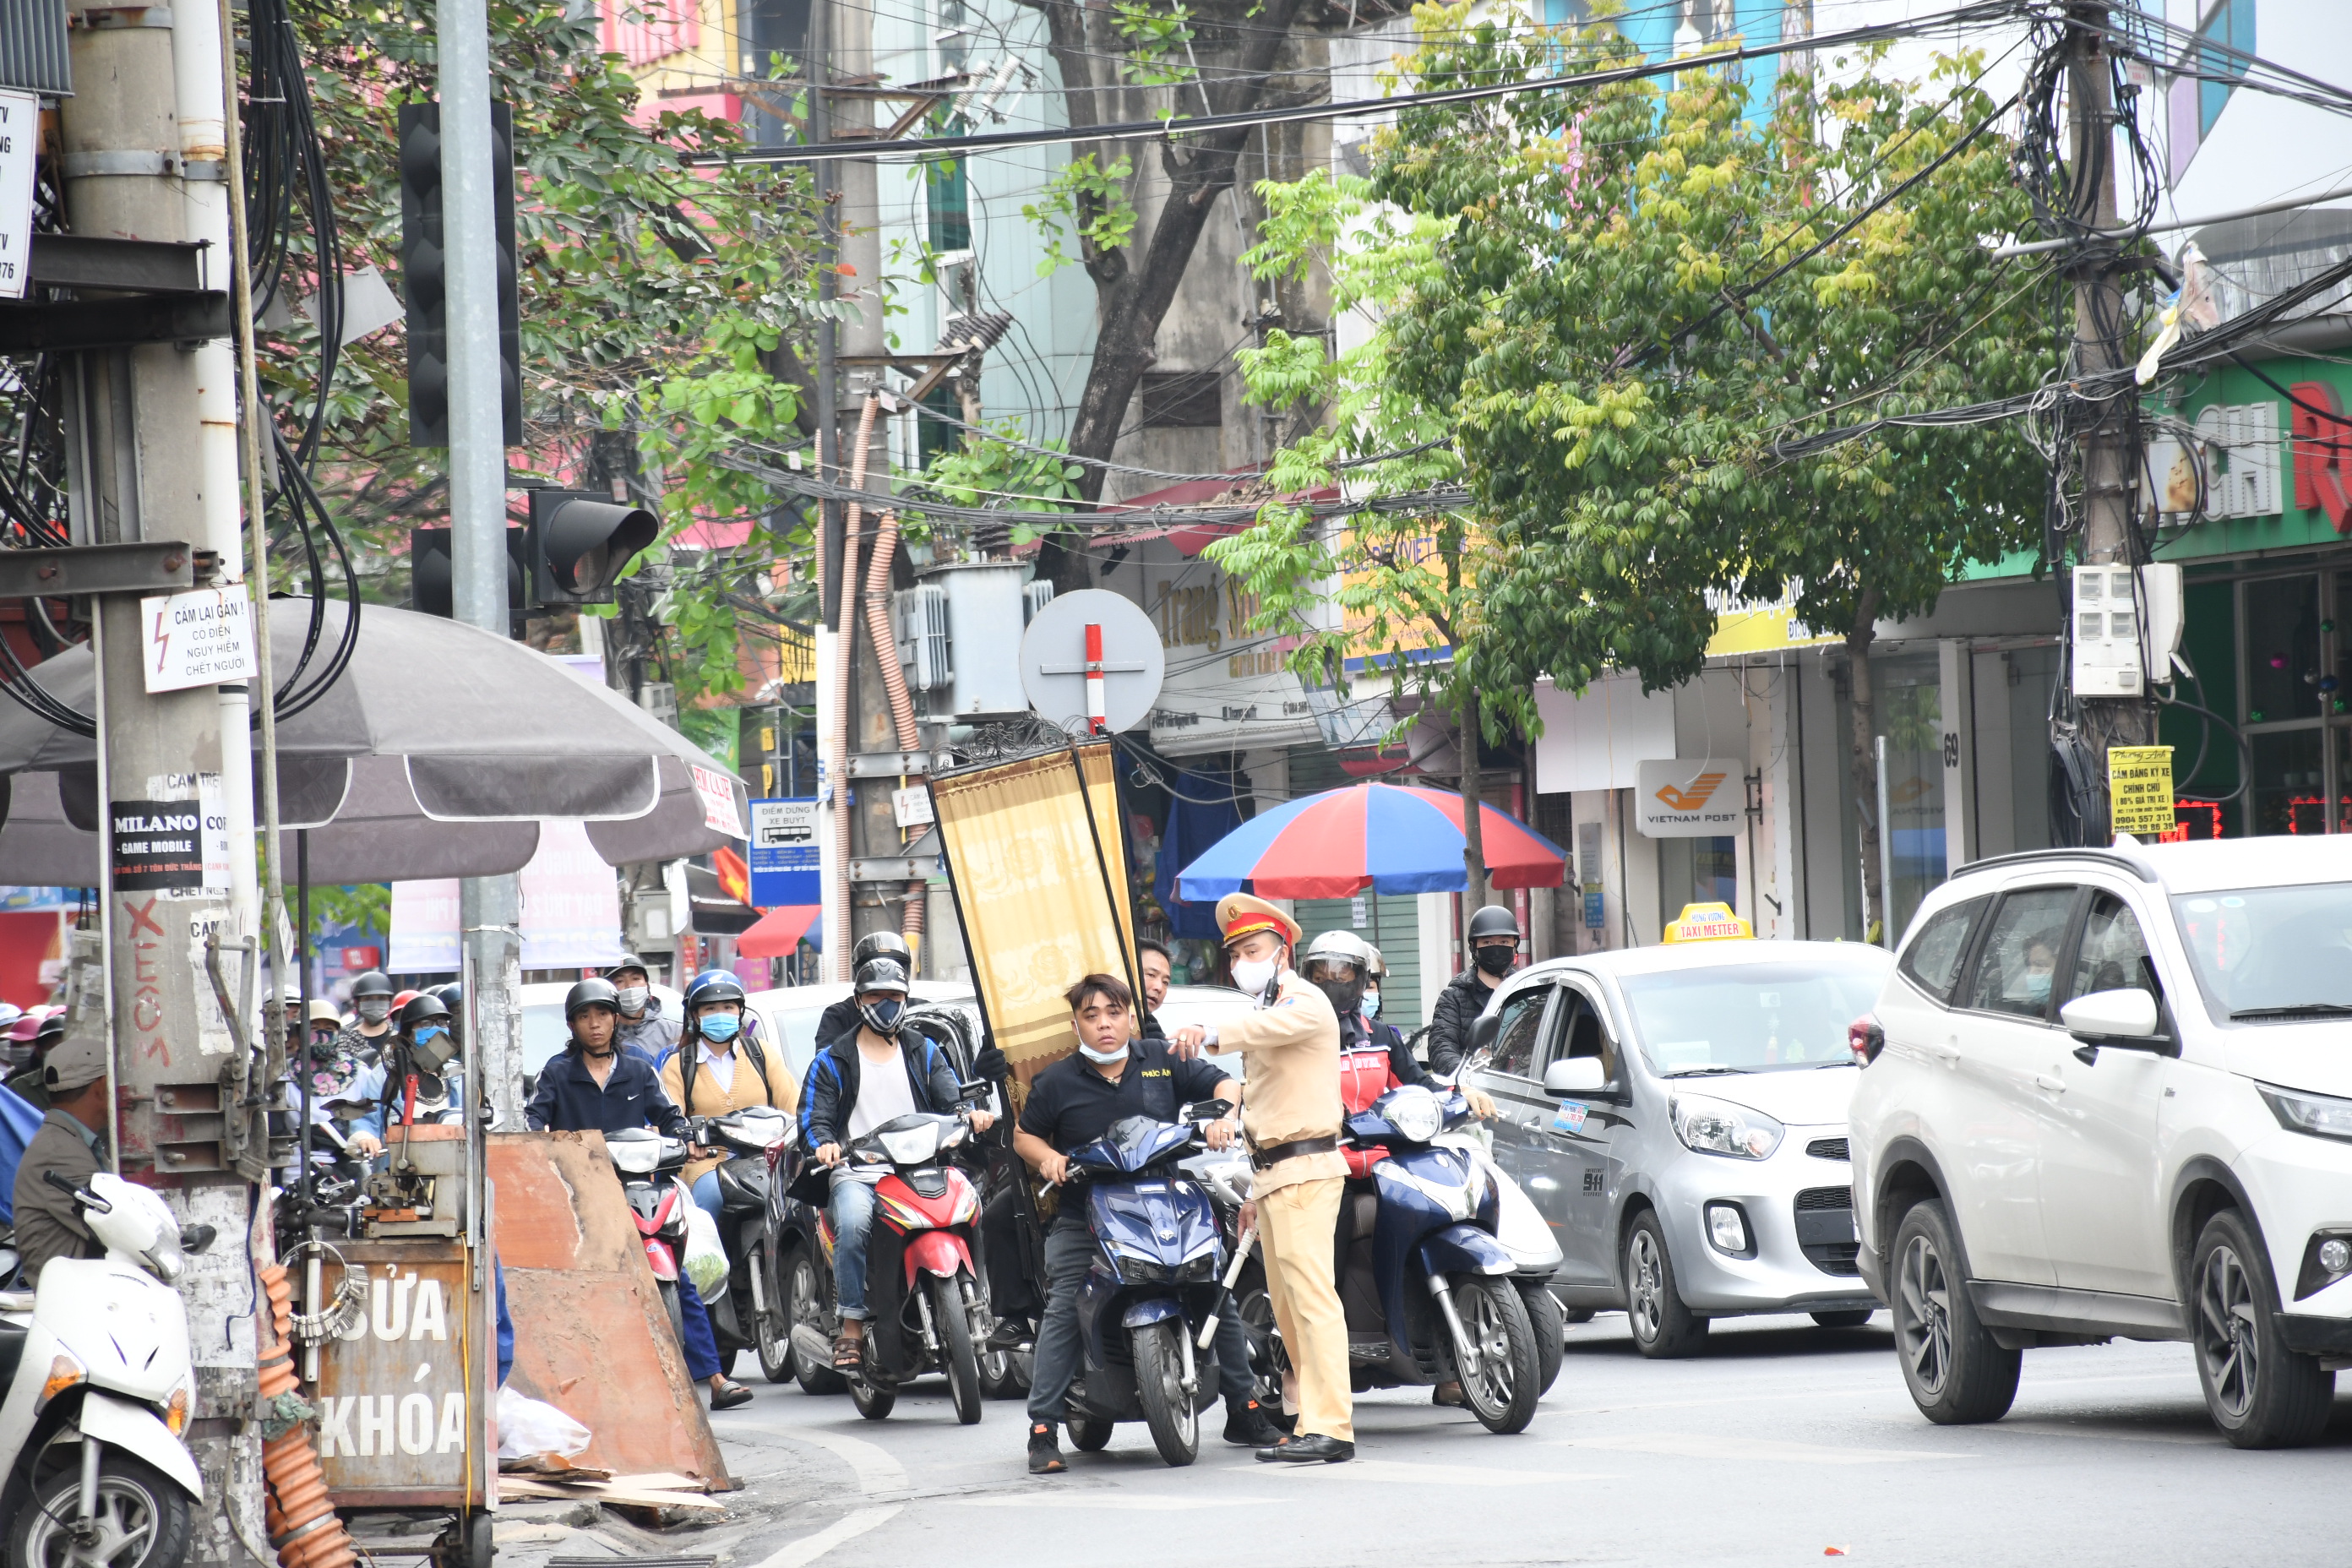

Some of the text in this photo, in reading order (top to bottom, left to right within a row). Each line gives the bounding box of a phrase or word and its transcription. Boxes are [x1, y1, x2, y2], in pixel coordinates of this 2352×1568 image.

[175, 602, 197, 625] CẤM
[199, 606, 214, 624] LẠI
[1157, 573, 1221, 653] Trang
[209, 624, 231, 640] ĐIỆN
[187, 645, 214, 658] NGUY
[1944, 733, 1958, 768] 69
[2130, 767, 2148, 778] ĐĂNG
[2161, 768, 2170, 776] XE
[2123, 782, 2144, 794] CHÍNH
[114, 815, 198, 833] MILANO
[1705, 814, 1736, 822] POST
[2156, 814, 2171, 822] 313
[122, 841, 149, 854] GAME
[151, 841, 192, 853] MOBILE
[1681, 923, 1739, 938] TAXI METTER
[320, 1363, 466, 1458] KHÓA
